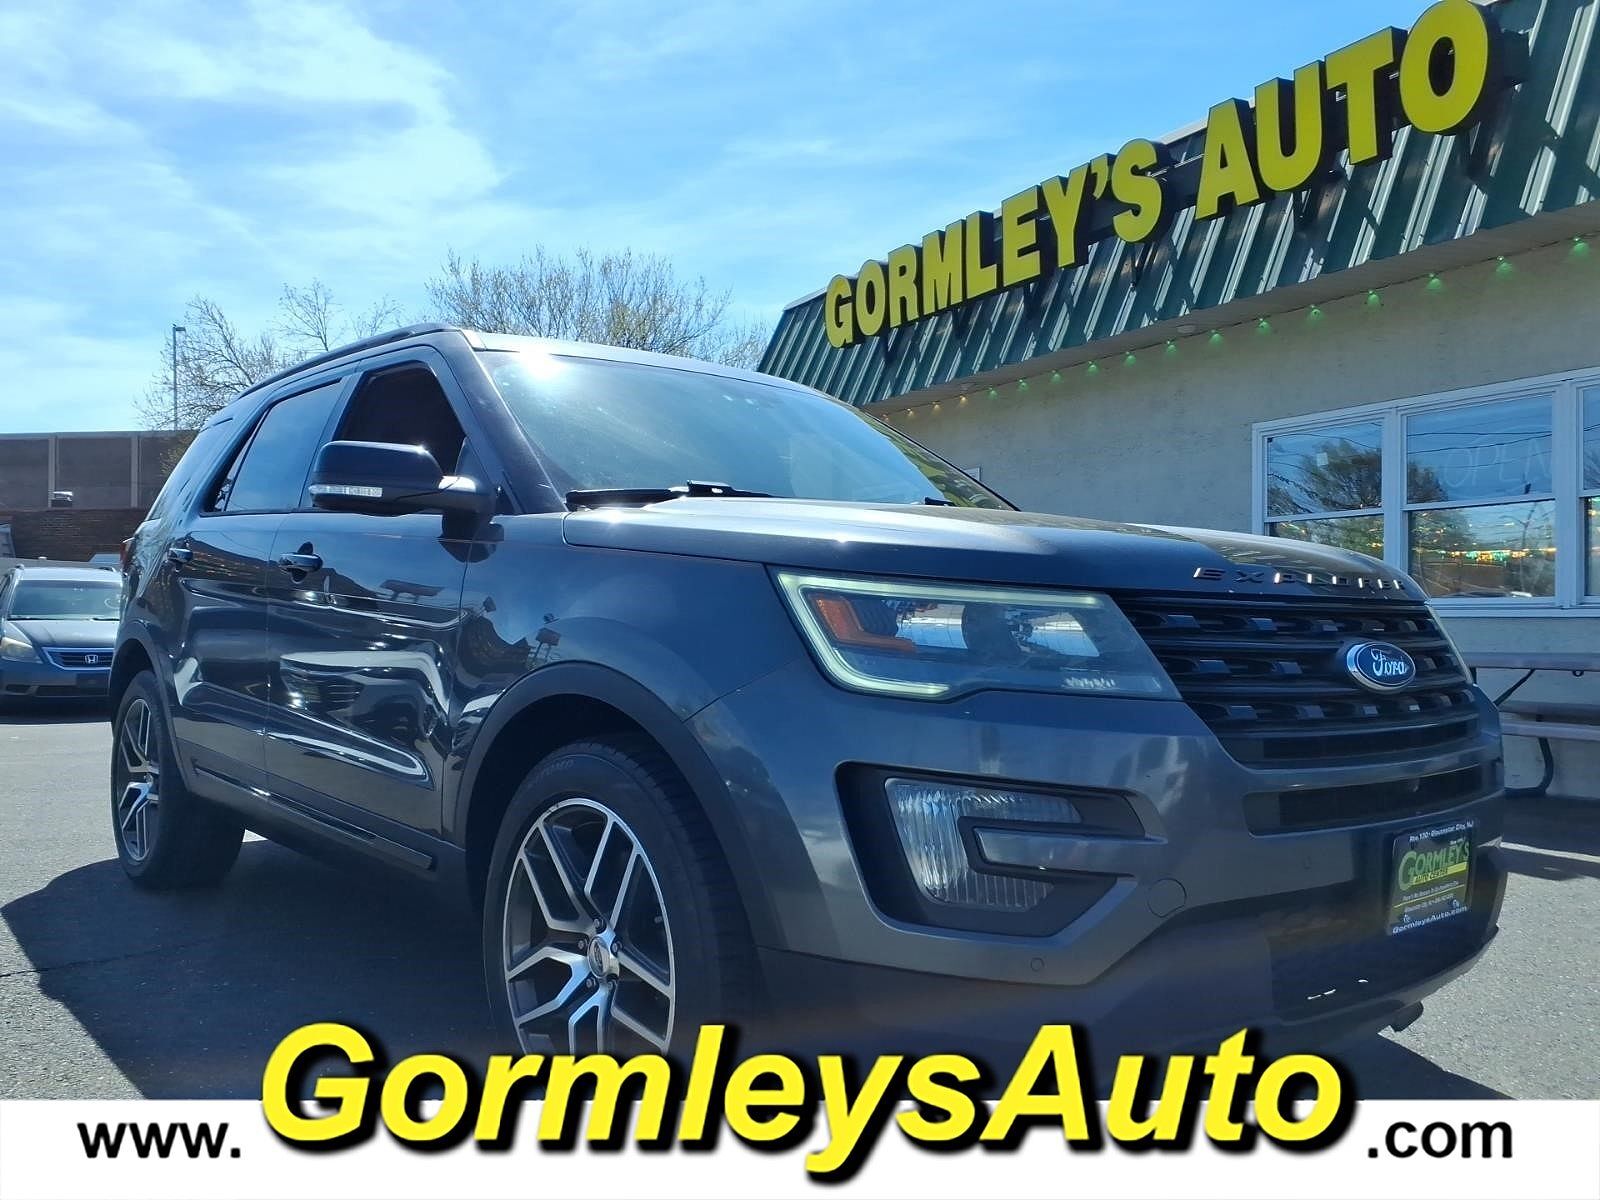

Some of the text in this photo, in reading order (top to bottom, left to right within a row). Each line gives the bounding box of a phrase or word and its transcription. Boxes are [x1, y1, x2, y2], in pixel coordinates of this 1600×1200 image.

[825, 0, 1490, 349] GORMLEY'S AUTO
[1193, 567, 1405, 590] EXPLORER
[1370, 648, 1408, 676] Ford
[1398, 841, 1470, 891] GORMLEY'S
